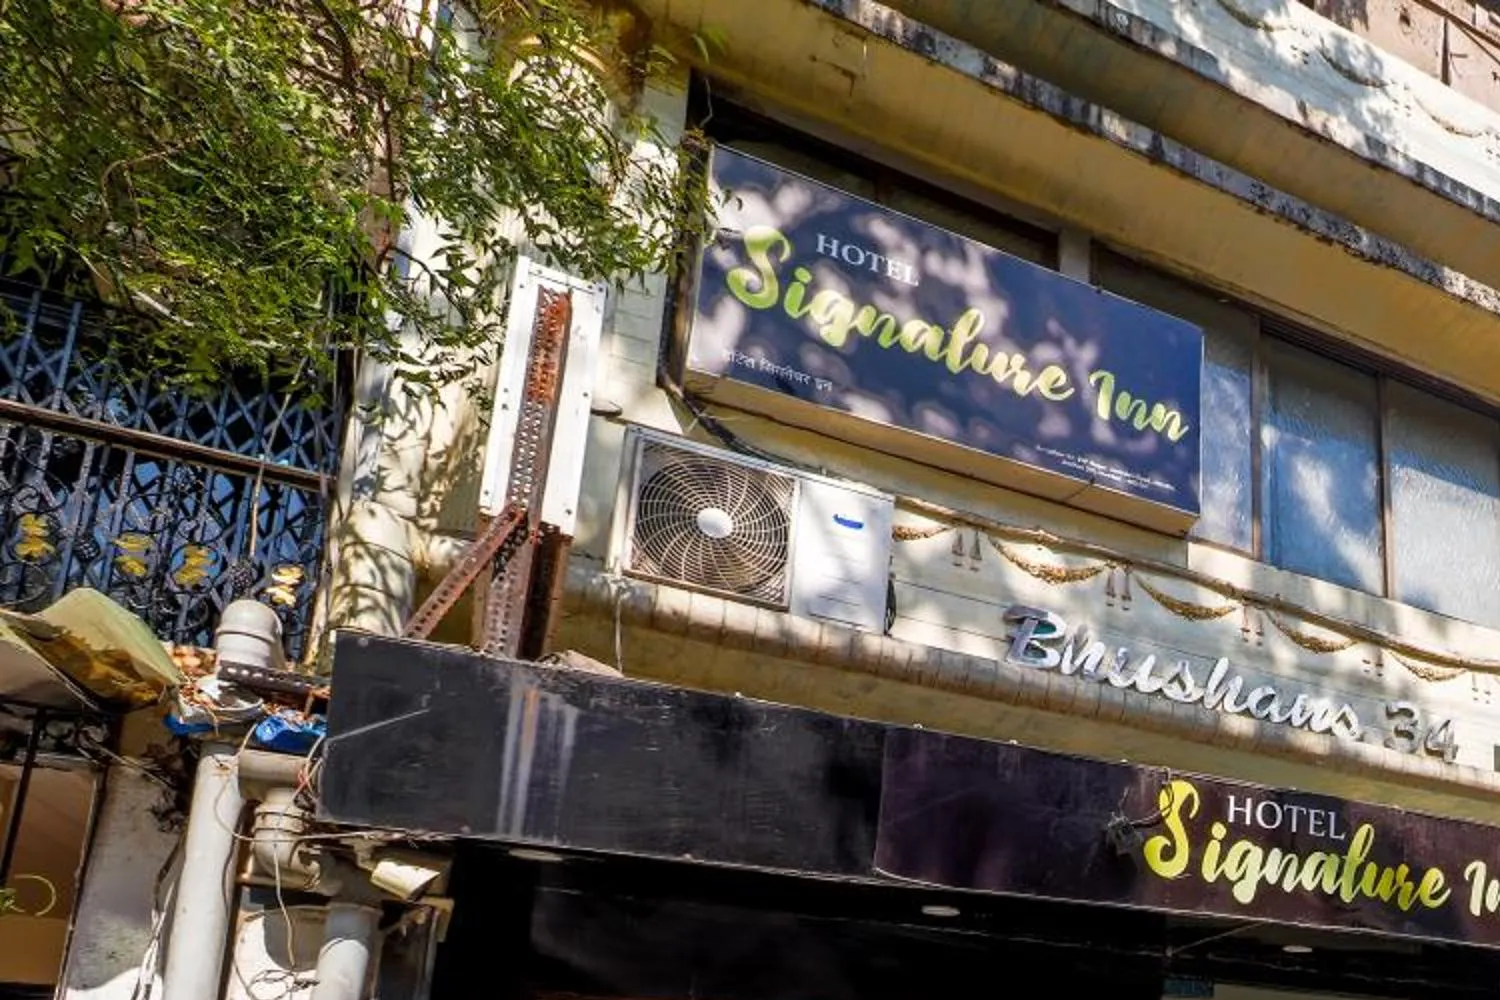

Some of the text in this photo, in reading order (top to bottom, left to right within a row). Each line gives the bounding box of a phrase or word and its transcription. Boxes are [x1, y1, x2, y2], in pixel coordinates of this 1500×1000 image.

[816, 233, 919, 287] HOTEL
[726, 226, 1188, 443] Signature Inn
[1383, 701, 1459, 764] 34
[1143, 778, 1452, 912] Signature
[1226, 795, 1346, 841] HOTEL
